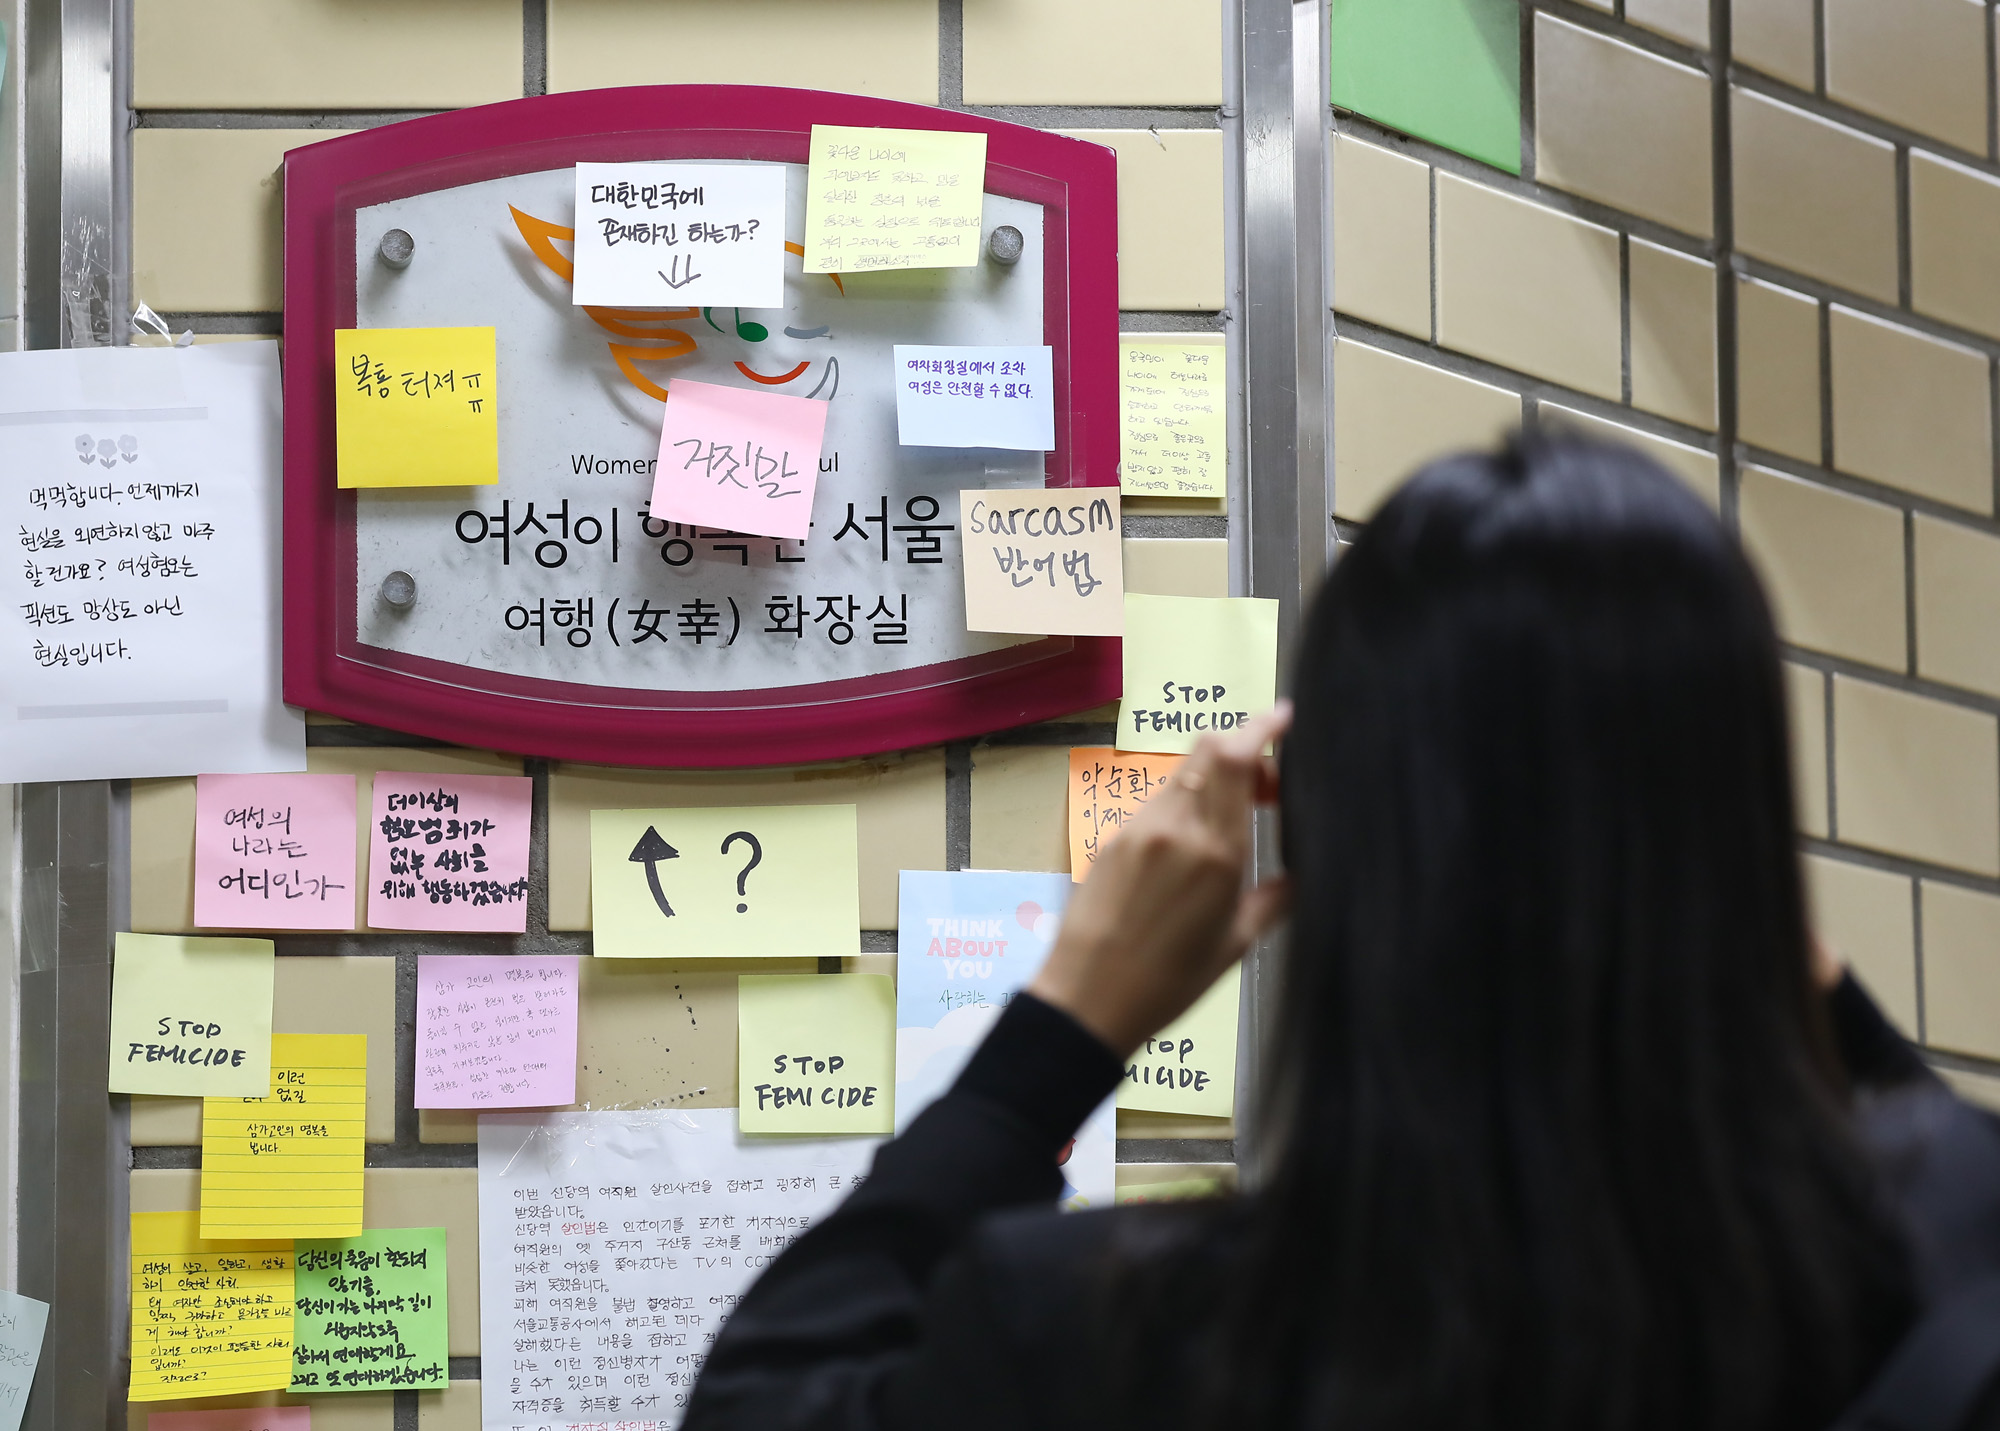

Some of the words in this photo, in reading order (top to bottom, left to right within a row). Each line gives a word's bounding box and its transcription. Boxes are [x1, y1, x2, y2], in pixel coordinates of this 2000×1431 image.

[591, 181, 704, 210] 대한민국에
[598, 218, 679, 247] 존재하긴
[687, 219, 760, 243] 하는가?
[907, 359, 995, 376] 여자화장실에서
[1000, 361, 1026, 376] 조차
[401, 369, 456, 399] 터져
[908, 380, 943, 395] 여성은
[947, 381, 985, 399] 안전할
[989, 383, 1000, 399] 수
[1004, 383, 1034, 399] 없다.
[673, 438, 802, 499] 거짓말
[29, 482, 124, 511] 먹먹합니다.
[127, 481, 200, 501] 언제까지
[18, 524, 66, 552] 현실을
[183, 522, 215, 540] 마주
[455, 499, 620, 569] 여성이
[832, 494, 955, 565] 서울
[118, 551, 199, 578] 여성혐오는
[993, 546, 1102, 597] 반어법
[20, 601, 75, 627] 픽션도
[83, 597, 138, 621] 망상도
[144, 595, 184, 616] 아닌
[504, 596, 742, 648] 여행(女幸)
[763, 593, 909, 646] 화장실
[33, 638, 132, 667] 현실입니다.
[1163, 681, 1226, 704] STOP
[1132, 709, 1250, 733] FEMICIDE
[1082, 762, 1166, 804] 악순환
[224, 806, 291, 835] 여성의
[233, 835, 308, 858] 나라는
[390, 847, 425, 880] 없는
[434, 843, 489, 873] 사회를
[720, 831, 763, 913] ?
[219, 867, 345, 901] 어디인가
[380, 879, 416, 899] 위해
[926, 917, 1005, 938] THINK
[926, 937, 1009, 958] ABOUT
[942, 959, 993, 980] YOU
[938, 989, 990, 1010] 사랑하는
[158, 1017, 222, 1039] STOP
[127, 1043, 247, 1067] FEMICIDE
[1146, 1037, 1194, 1063] TOP
[774, 1054, 844, 1075] STOP
[277, 1069, 306, 1085] 이런
[276, 1087, 307, 1103] 없길
[300, 1123, 329, 1137] 명복을
[249, 1141, 282, 1155] 빕니다.
[513, 1188, 539, 1201] 이번
[550, 1185, 590, 1199] 신당역
[598, 1186, 638, 1200] 여직원
[650, 1179, 713, 1196] 살인사건을
[726, 1179, 764, 1193] 접하고
[776, 1177, 816, 1192] 굉장히
[828, 1176, 842, 1190] 큰
[514, 1222, 551, 1236] 신당역
[560, 1221, 609, 1236] 살인범은
[622, 1217, 685, 1234] 인간이기를
[699, 1214, 736, 1230] 포기한
[513, 1243, 562, 1258] 여직원의
[604, 1239, 643, 1253] 주거지
[656, 1236, 692, 1250] 구산동
[702, 1235, 742, 1251] 근처를
[142, 1262, 171, 1276] 여성이
[183, 1262, 208, 1276] 살고,
[298, 1249, 343, 1272] 당신의
[344, 1249, 380, 1272] 죽음이
[514, 1260, 551, 1276] 비슷한
[563, 1259, 601, 1276] 여성을
[142, 1277, 163, 1292] 하기
[173, 1295, 202, 1309] 여자만
[214, 1295, 251, 1308] 조심해야
[255, 1293, 274, 1305] 하고
[295, 1297, 335, 1317] 당신이
[407, 1292, 432, 1313] 길이
[513, 1298, 538, 1312] 피해
[549, 1297, 598, 1313] 여직원을
[612, 1297, 636, 1314] 불법
[193, 1324, 233, 1339] 합니까?
[513, 1316, 612, 1333] 서울교통공사에서
[624, 1315, 667, 1329] 해고된
[674, 1314, 704, 1328] 데다
[151, 1345, 181, 1357] 이래도
[190, 1344, 222, 1355] 이것이
[512, 1336, 582, 1352] 살해했다는
[597, 1333, 633, 1349] 내용을
[647, 1332, 687, 1347] 접하고
[150, 1358, 187, 1371] 입니까?
[513, 1358, 539, 1373] 나는
[554, 1357, 582, 1371] 이런
[510, 1377, 521, 1394] 을
[567, 1374, 608, 1391] 있으며
[623, 1373, 651, 1388] 이런
[512, 1398, 565, 1415] 자격증을
[579, 1395, 622, 1414] 취득할
